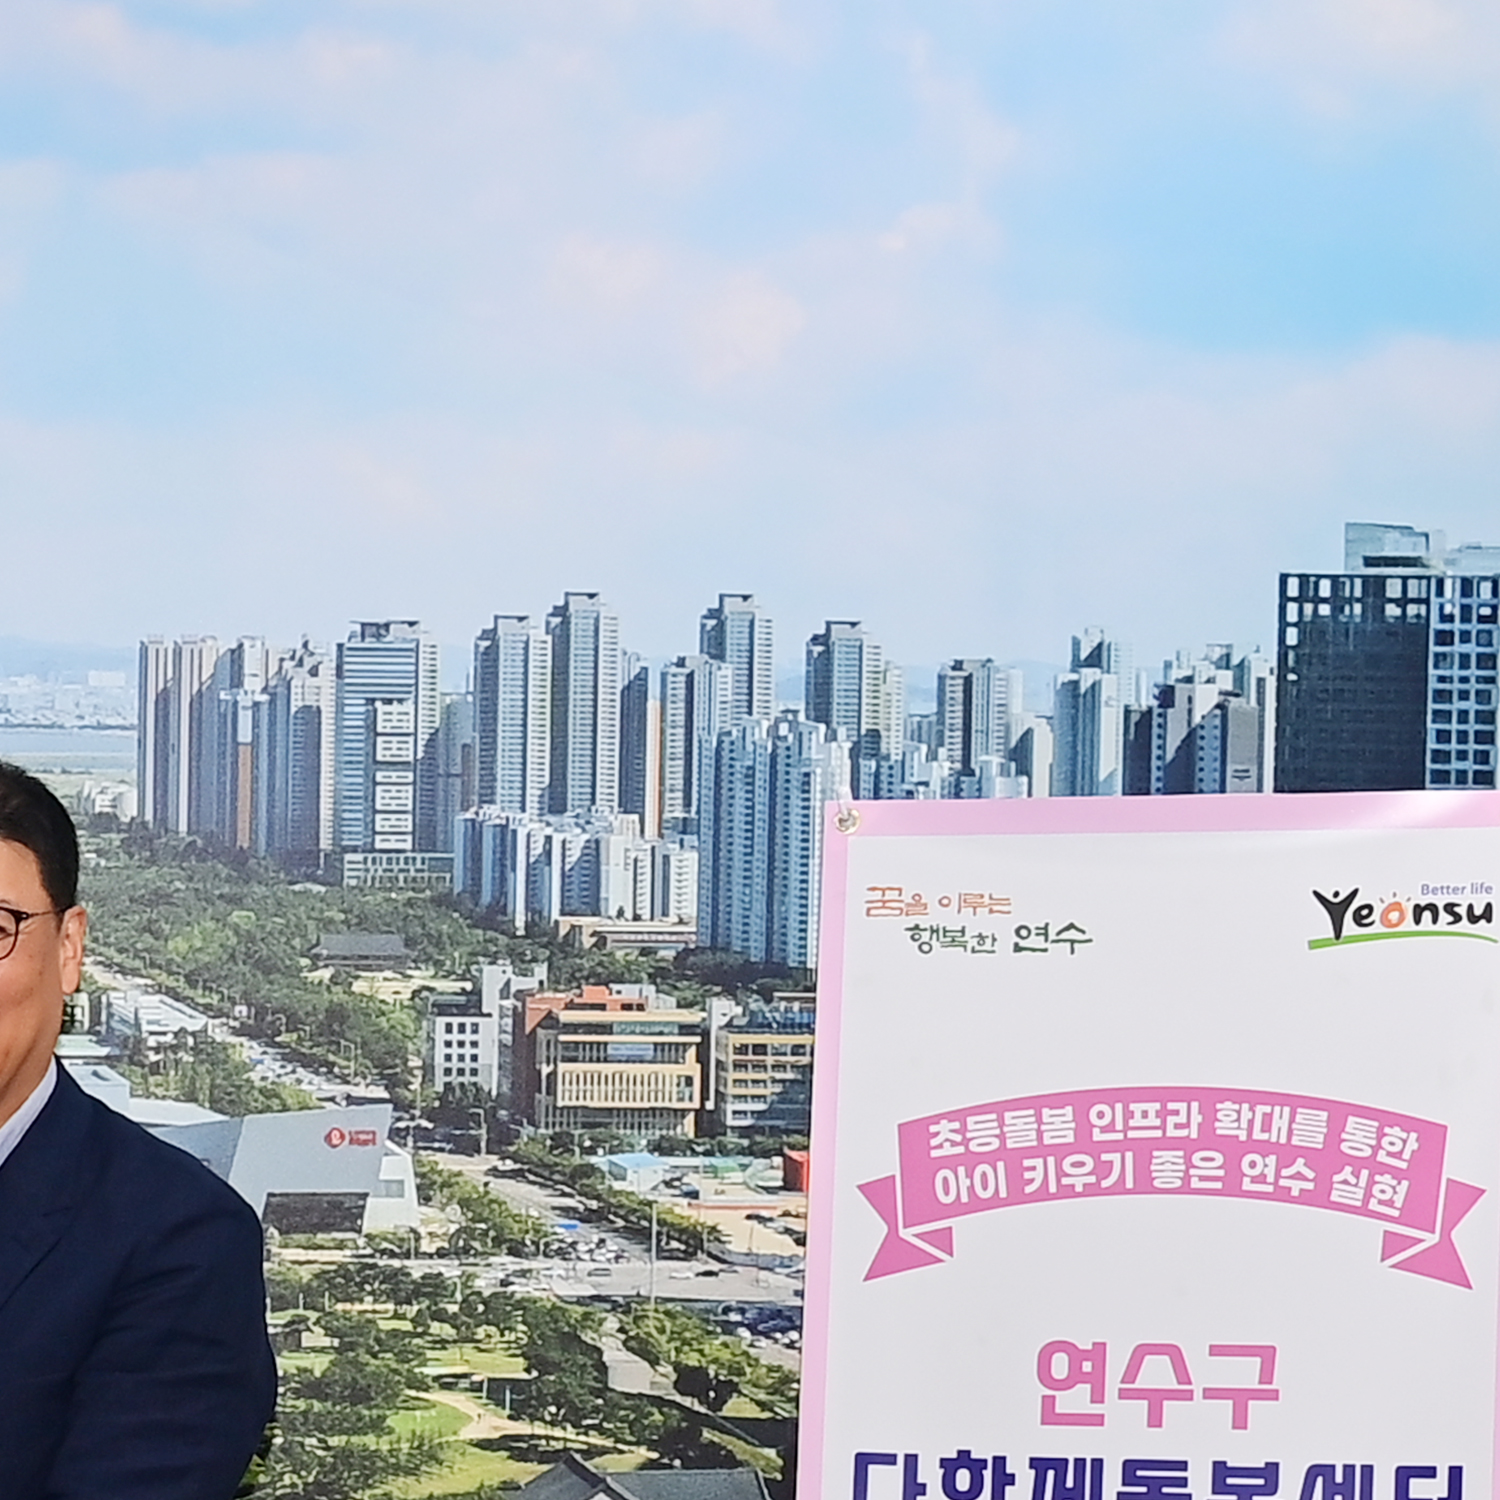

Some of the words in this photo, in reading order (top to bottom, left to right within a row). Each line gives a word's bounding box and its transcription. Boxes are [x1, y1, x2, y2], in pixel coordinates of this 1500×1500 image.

[864, 886, 929, 917] 꿈을
[938, 892, 1012, 916] 이루는
[1312, 888, 1493, 941] Yeonsu
[1421, 883, 1467, 897] Better
[1470, 882, 1493, 896] life
[904, 923, 997, 955] 행복한
[1012, 922, 1093, 955] 연수
[928, 1106, 1076, 1158] 초등돌봄
[1088, 1101, 1202, 1141] 인프라
[1214, 1101, 1328, 1149] 확대를
[1339, 1115, 1419, 1169] 통한
[934, 1161, 1008, 1204] 아이
[1022, 1151, 1135, 1194] 키우기
[1149, 1150, 1225, 1189] 좋은
[1240, 1153, 1316, 1197] 연수
[1329, 1164, 1409, 1218] 실현
[1037, 1340, 1280, 1430] 연수구
